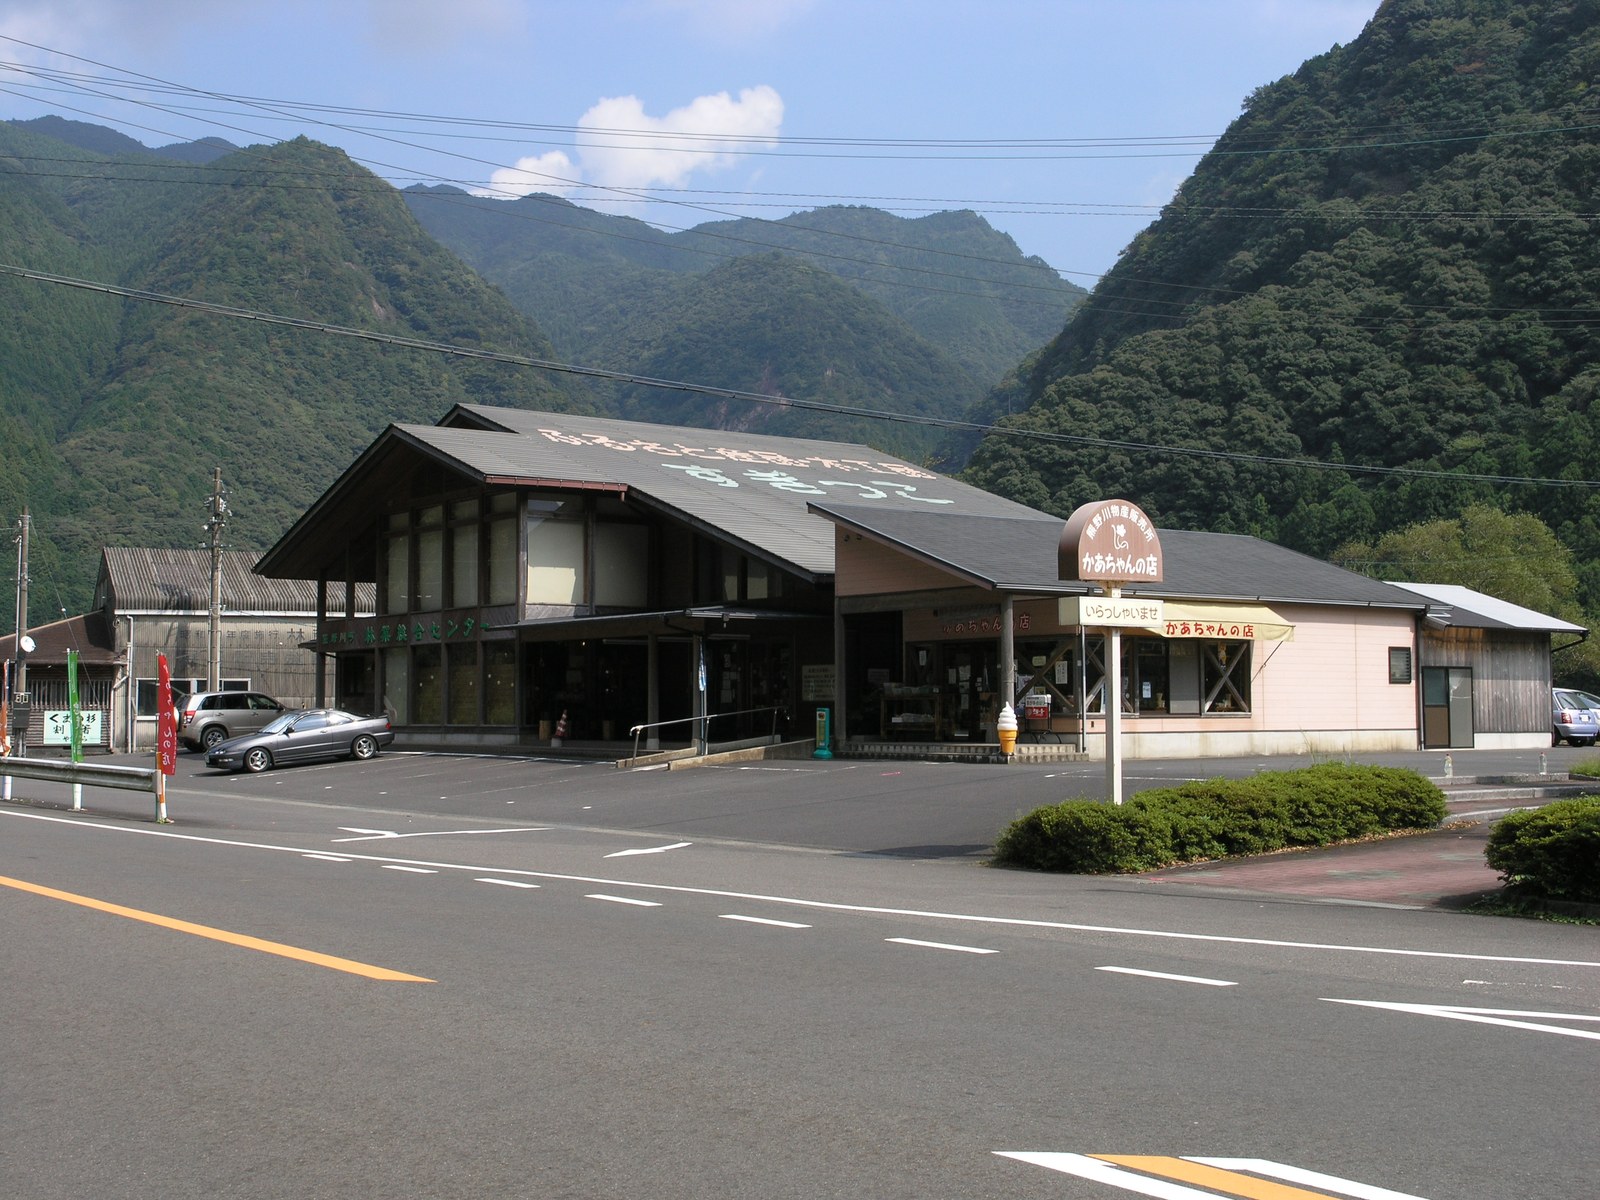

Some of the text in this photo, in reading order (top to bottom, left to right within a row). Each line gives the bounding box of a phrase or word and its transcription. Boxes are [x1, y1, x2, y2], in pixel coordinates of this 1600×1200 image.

[1085, 504, 1155, 543] 熊野川物産販売所
[1082, 552, 1158, 577] かあちゃんの店
[1085, 604, 1158, 621] いらっしゃいませ
[1165, 622, 1254, 638] かあちゃんの店
[49, 713, 96, 724] くま杉
[53, 724, 91, 735] 割箸
